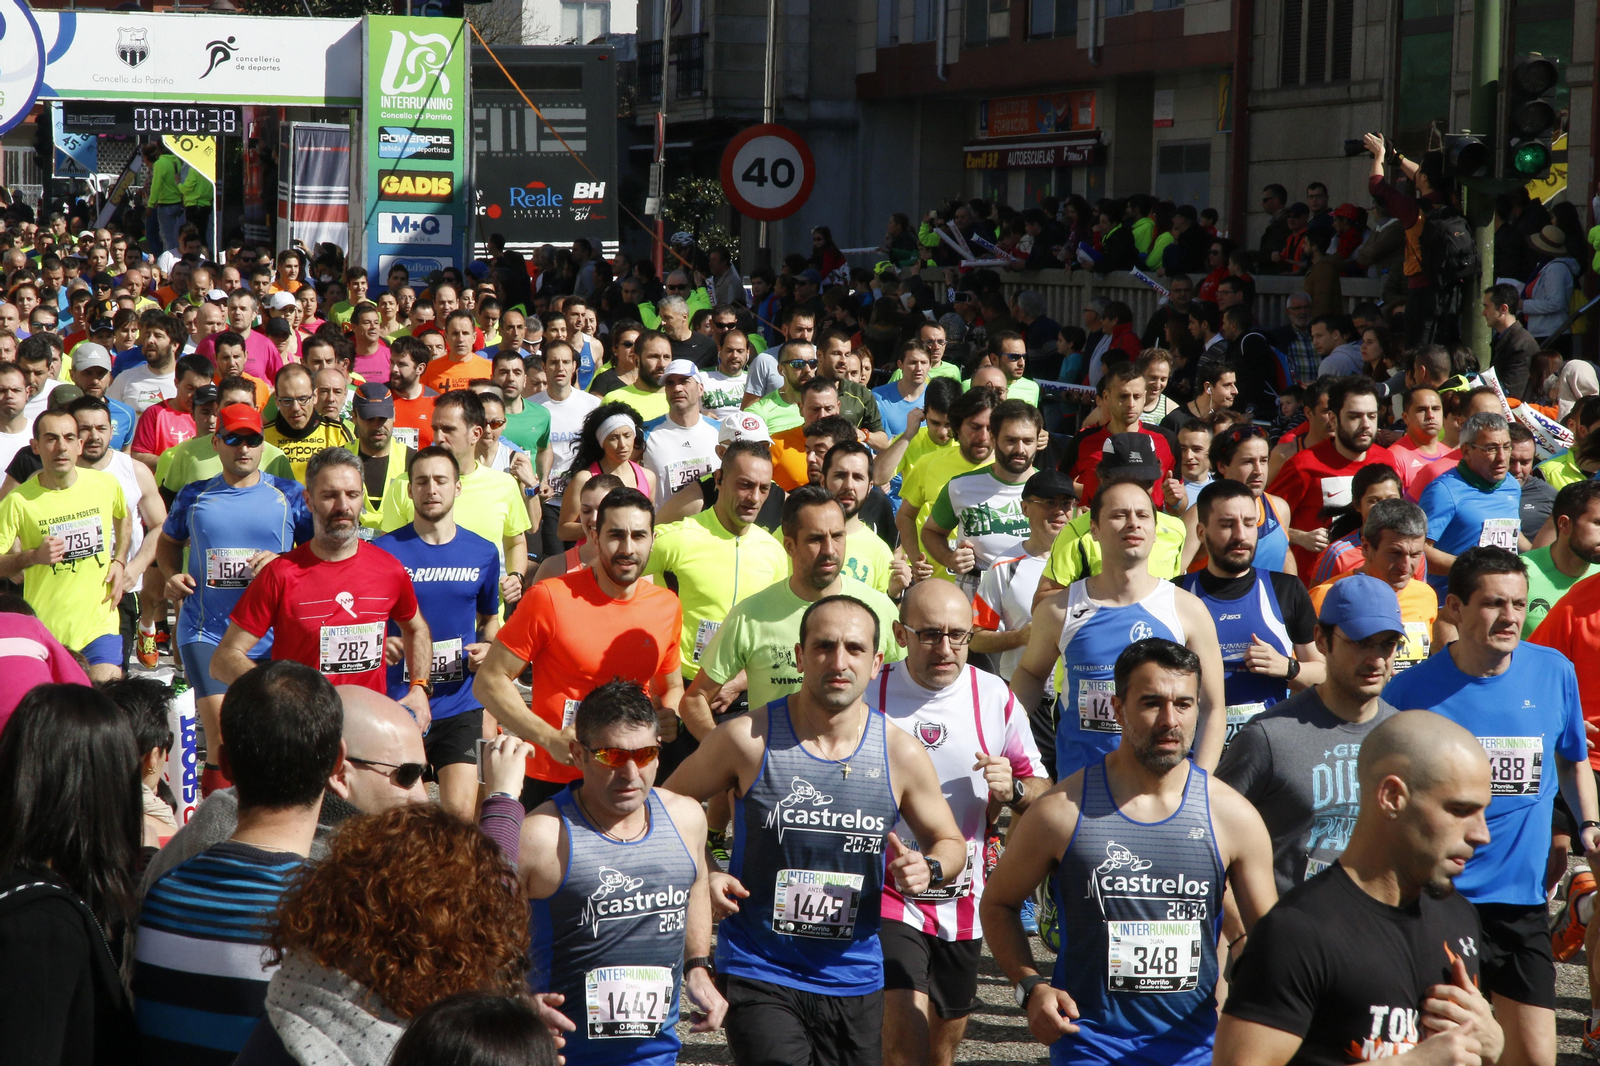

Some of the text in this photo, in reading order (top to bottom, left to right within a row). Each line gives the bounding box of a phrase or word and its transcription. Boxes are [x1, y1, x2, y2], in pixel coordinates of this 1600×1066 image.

[92, 74, 174, 85] Concello do Porriño
[381, 96, 453, 110] INTERRUNNING
[995, 101, 1028, 116] CENTRO DE
[135, 108, 236, 132] 00:00:38
[426, 113, 452, 121] Porriño
[380, 134, 452, 145] POWERADE
[967, 152, 998, 169] Carril 32
[1007, 149, 1055, 166] AUTOESCUELAS
[742, 157, 795, 188] 40
[382, 176, 452, 196] GADIS
[573, 182, 605, 199] BH
[510, 187, 563, 208] Reale
[391, 215, 440, 235] M+Q
[1519, 413, 1539, 434] SPORT
[1538, 431, 1548, 443] TO
[680, 469, 701, 484] 258
[49, 514, 76, 525] CARREIRA
[76, 507, 100, 520] PEDESTRE
[65, 532, 91, 551] 735
[1491, 531, 1507, 546] 247
[219, 562, 247, 579] 1512
[413, 567, 480, 582] RUNNING
[328, 624, 377, 637] INTERRUNNING
[338, 640, 369, 661] 282
[783, 809, 885, 831] castrelos
[843, 836, 882, 855] 20:30
[787, 871, 853, 887] INTERRUNNING
[1100, 873, 1210, 896] castrelos
[794, 893, 844, 923] 1445
[1166, 901, 1207, 920] 20:30
[808, 925, 831, 933] Porriño
[1120, 923, 1190, 936] INTERRUNNING
[1133, 946, 1178, 975] 348
[597, 968, 665, 982] INTERRUNNING
[607, 991, 658, 1020] 1442
[626, 1022, 649, 1031] Porriño
